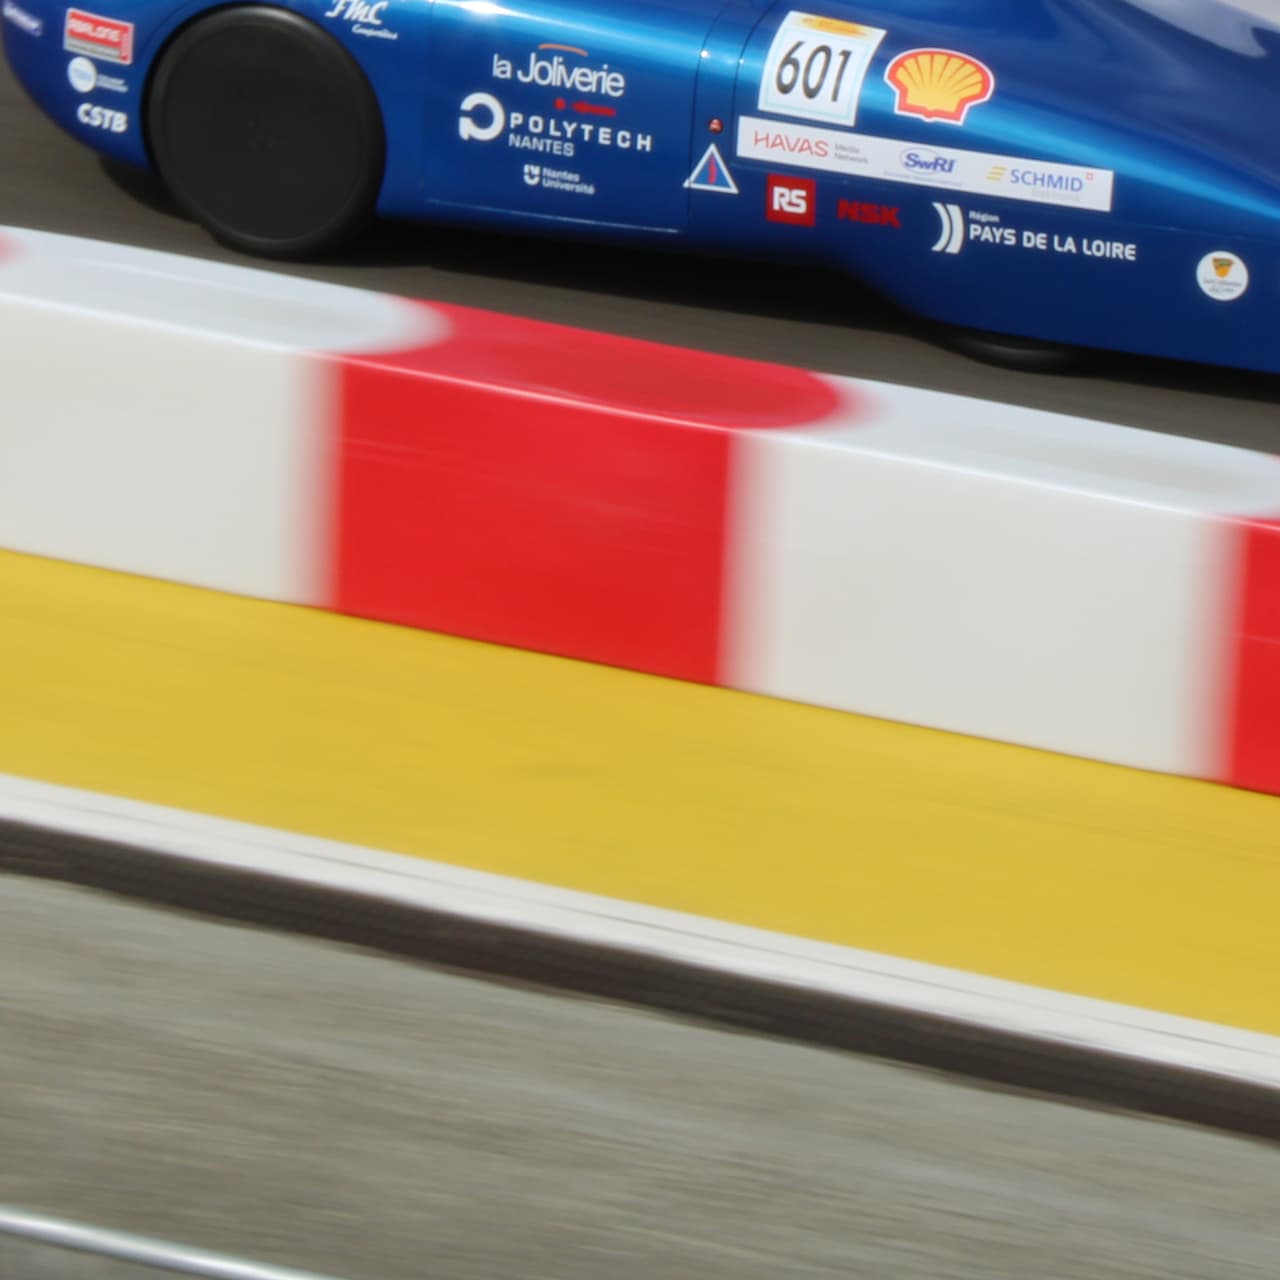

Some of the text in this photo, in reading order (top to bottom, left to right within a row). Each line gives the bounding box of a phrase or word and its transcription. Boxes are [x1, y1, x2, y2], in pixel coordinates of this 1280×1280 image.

[492, 52, 625, 97] la Joliverie
[776, 41, 853, 103] 601
[77, 102, 128, 133] CSTB
[509, 111, 653, 153] POLYTECH
[508, 133, 575, 157] NANTES
[753, 130, 830, 159] HAVAS
[542, 167, 580, 183] Nantes
[1010, 168, 1084, 193] SCHMID
[772, 186, 808, 215] RS
[837, 199, 902, 228] NSK
[969, 224, 1137, 262] PAYS DE LA LOIRE
